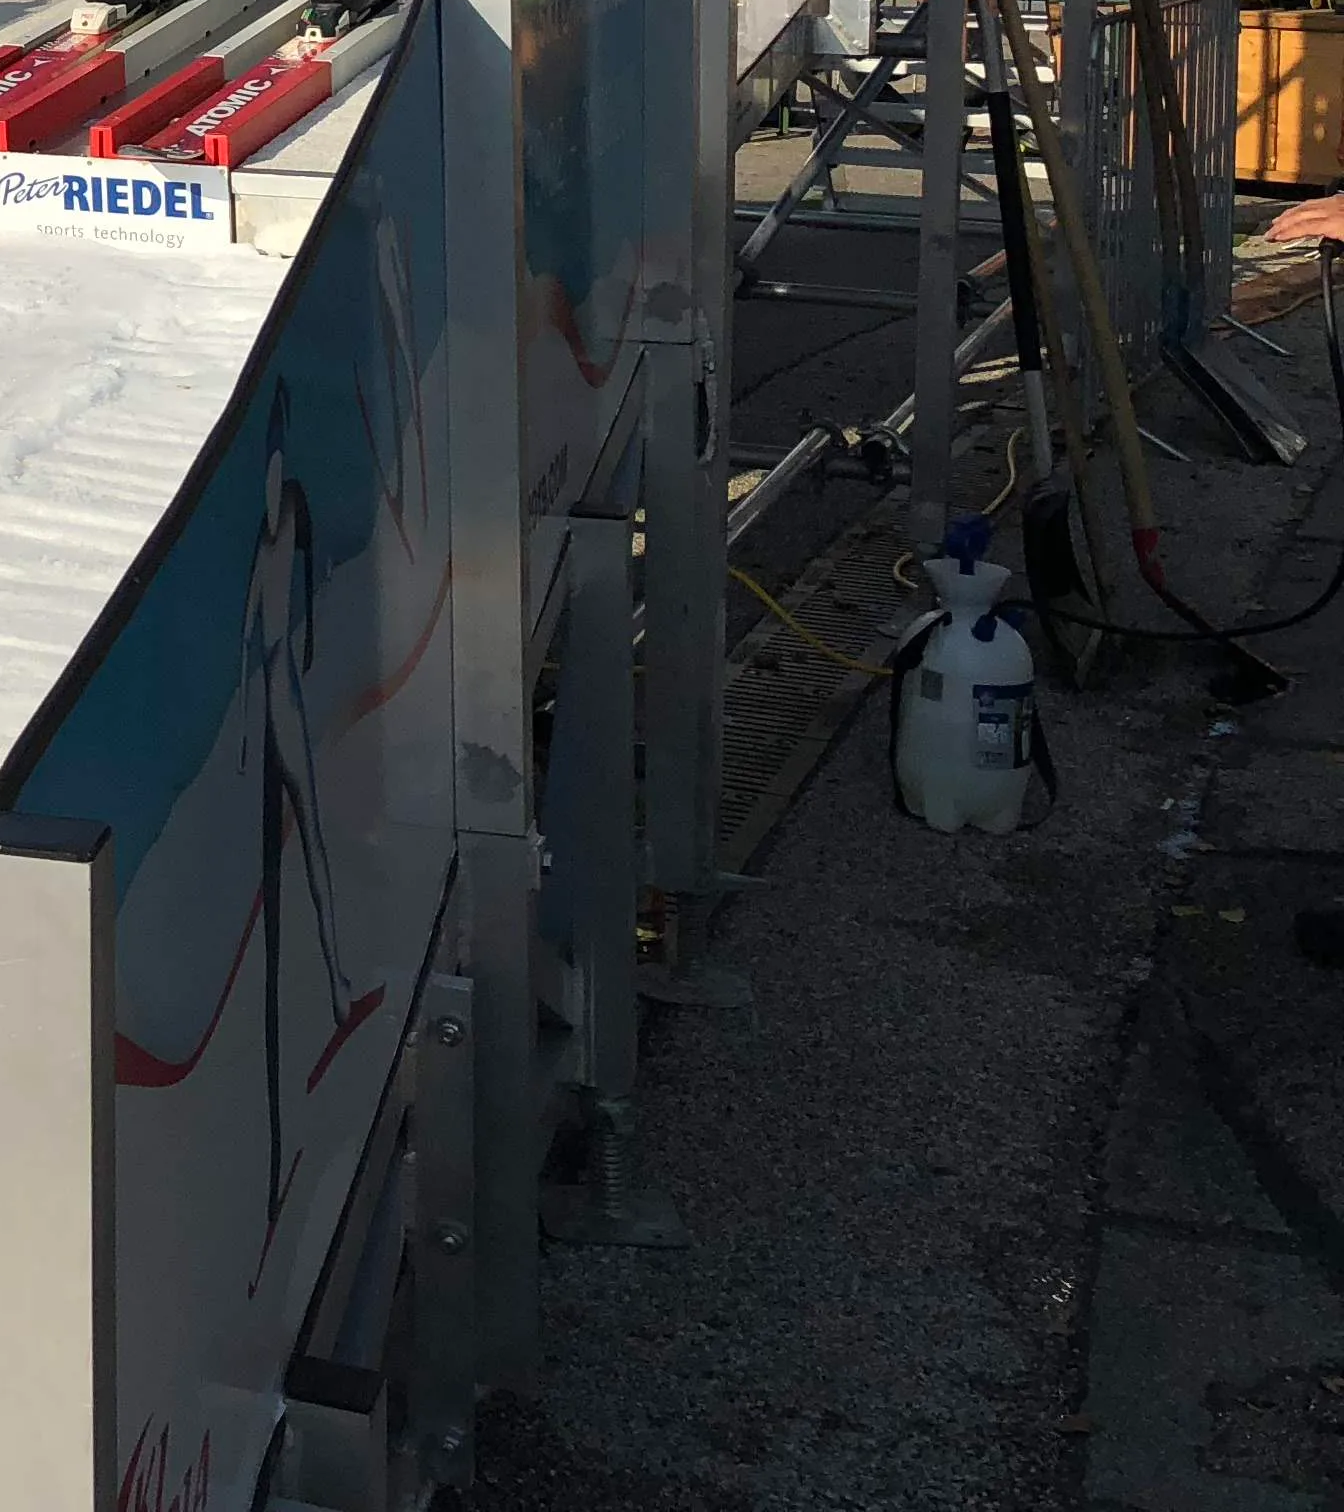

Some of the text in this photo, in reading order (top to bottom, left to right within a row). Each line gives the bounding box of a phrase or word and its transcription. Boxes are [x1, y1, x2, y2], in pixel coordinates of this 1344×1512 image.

[185, 79, 273, 137] ATOMIC
[63, 174, 215, 220] RIEDEL
[36, 222, 185, 249] sports technology
